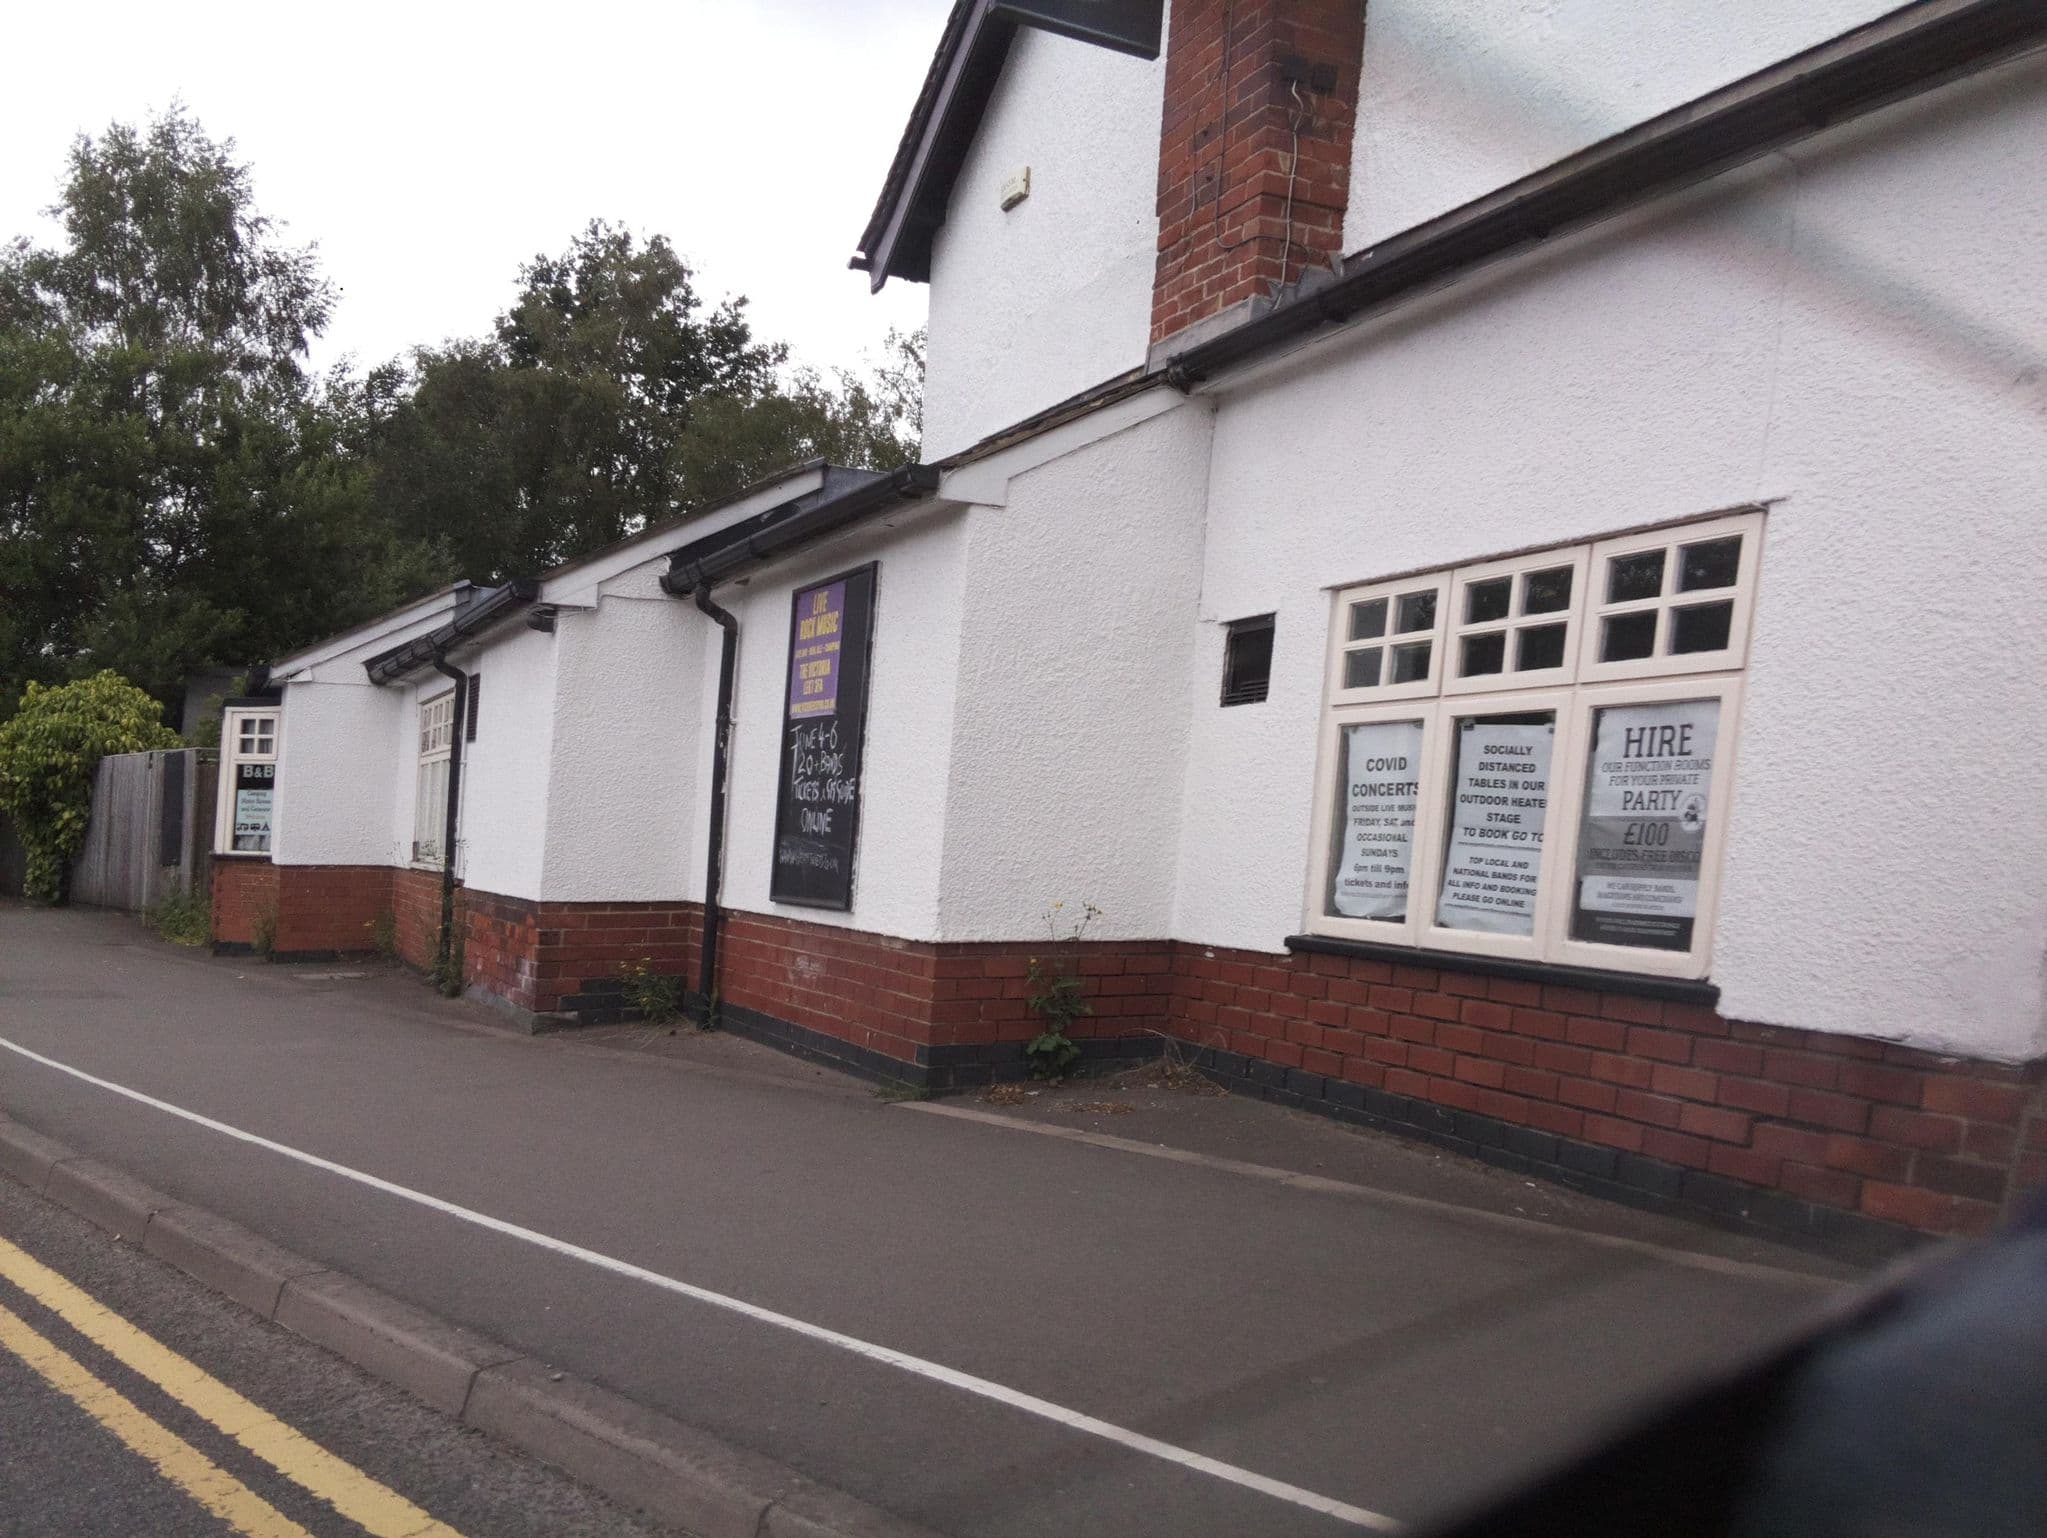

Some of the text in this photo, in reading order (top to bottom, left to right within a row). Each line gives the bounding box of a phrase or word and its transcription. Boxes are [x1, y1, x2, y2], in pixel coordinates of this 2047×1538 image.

[813, 591, 829, 615] LIVE
[816, 611, 839, 636] MUSIC
[790, 725, 817, 750] JUNE
[1623, 724, 1693, 758] HIRE
[1484, 745, 1533, 755] SOCIALLY
[1366, 757, 1407, 772] COVID
[1479, 762, 1536, 773] DISTANCED
[243, 766, 274, 778] B&B
[1352, 782, 1419, 797] CONCERTS
[1469, 778, 1545, 791] TABLES IN OUR
[1460, 794, 1547, 809] OUTDOOR HEATE
[1622, 790, 1682, 811] PARTY
[1487, 813, 1521, 824] STAGE
[1357, 833, 1408, 842] OCCASIONAL
[1464, 827, 1476, 837] TO
[1479, 829, 1509, 840] BOOK
[1512, 832, 1528, 841] GO
[1624, 823, 1669, 846] £100
[1361, 848, 1398, 858] SUNDAYS
[1485, 858, 1509, 867] LOCAL
[1511, 861, 1529, 869] AND
[1453, 868, 1489, 878] NATIONAL
[1491, 872, 1518, 881] BANDS
[1345, 879, 1372, 888] tickets
[1375, 881, 1392, 889] and
[1448, 880, 1460, 888] ALL
[1463, 881, 1480, 889] INFO
[1482, 883, 1498, 891] AND
[1453, 893, 1525, 908] PLEASE GO ONLINE
